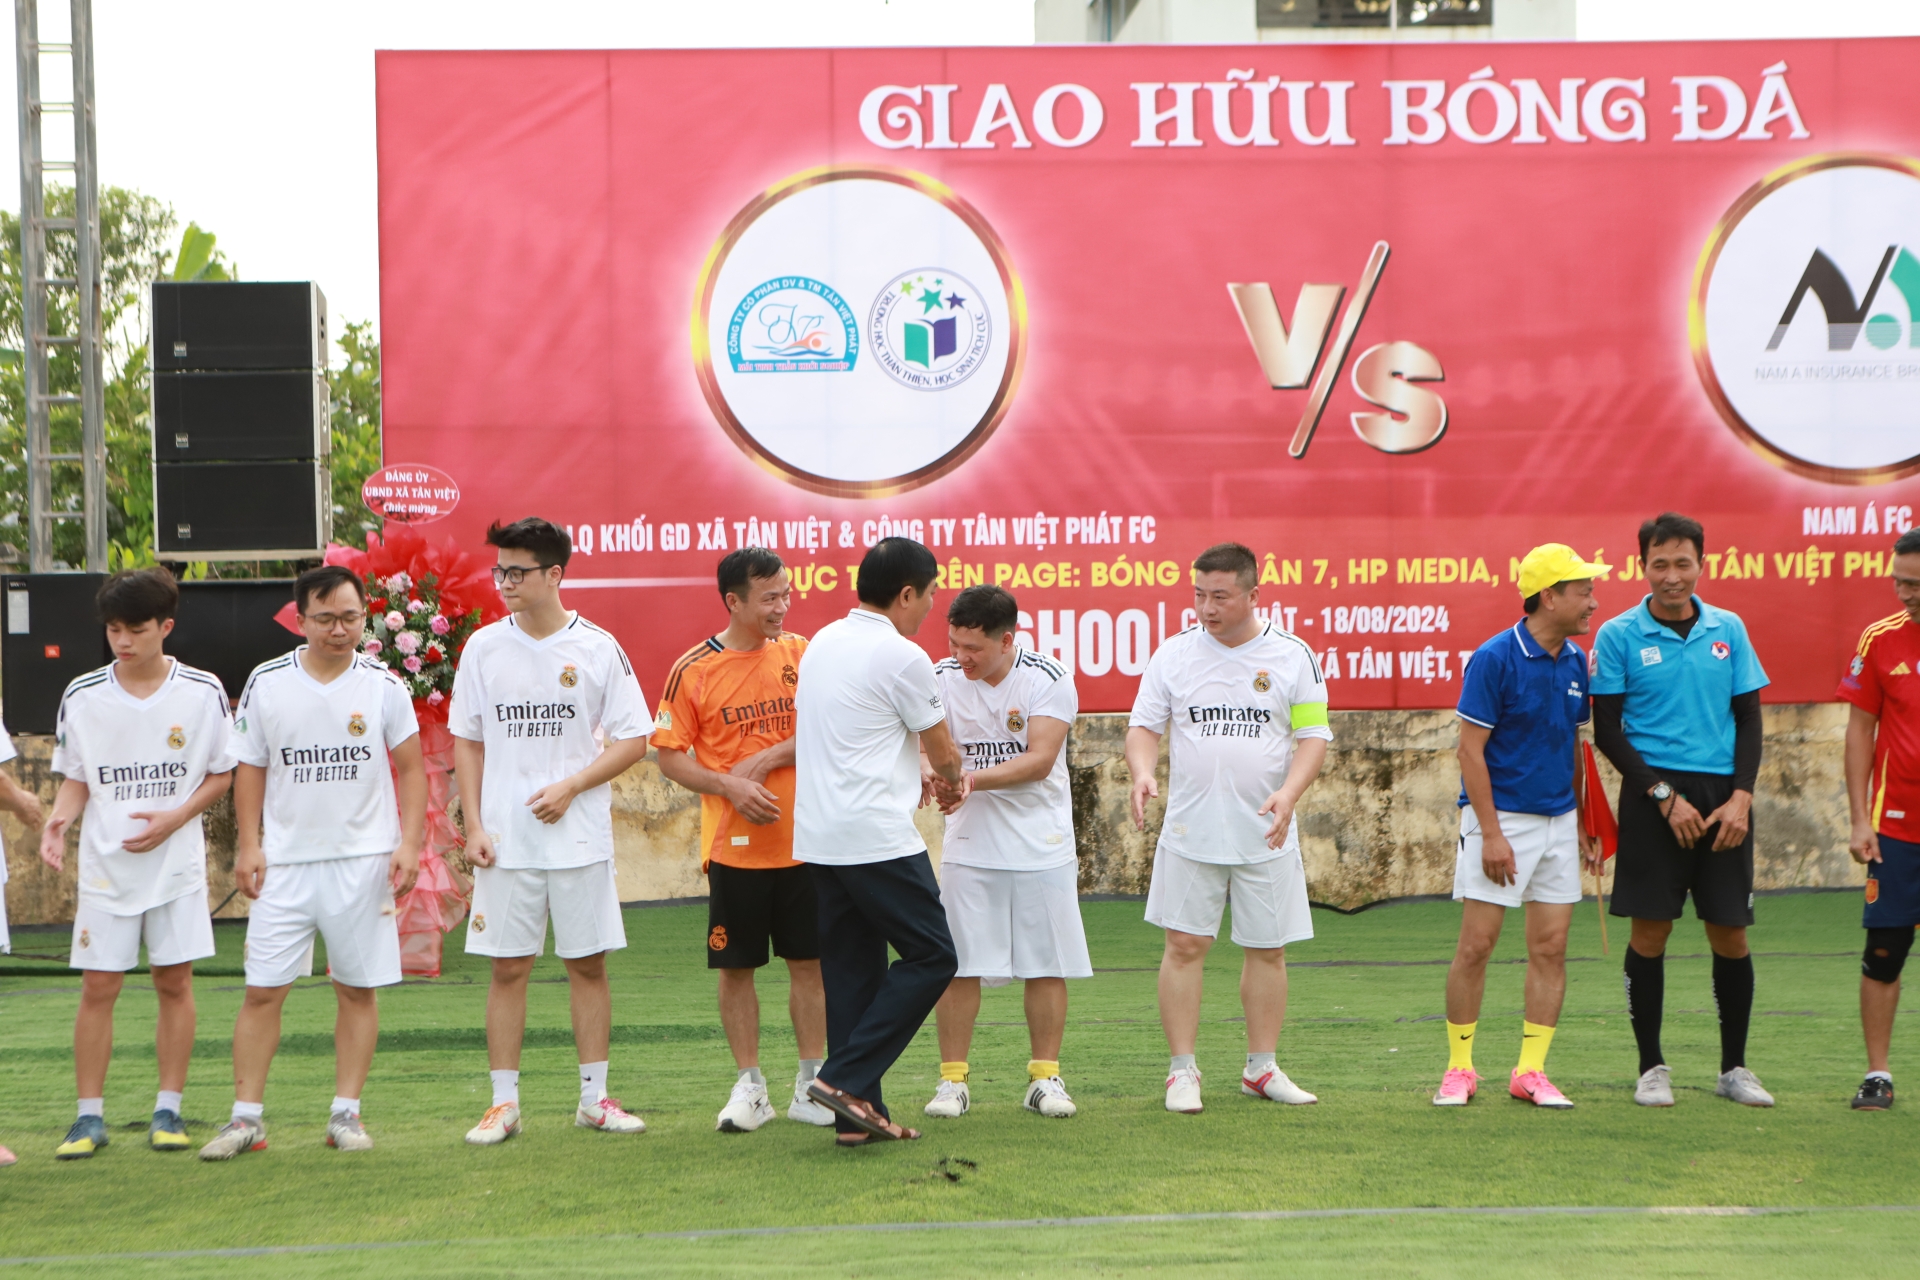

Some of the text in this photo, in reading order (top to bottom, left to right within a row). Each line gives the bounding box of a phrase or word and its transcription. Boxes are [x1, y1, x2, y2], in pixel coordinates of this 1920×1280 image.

[859, 60, 1810, 149] GIAO HỮU BÓNG ĐÁ
[735, 310, 745, 324] TY
[782, 279, 797, 288] DV
[798, 279, 805, 288] &
[808, 280, 822, 293] TM
[956, 356, 976, 376] SINH
[1755, 366, 1788, 379] NAM
[1805, 365, 1893, 379] INSURANCE
[365, 486, 393, 497] UBND
[1803, 501, 1913, 536] NAM Á FC
[601, 514, 653, 552] KHỐI
[660, 523, 690, 551] GD
[697, 517, 728, 550] XÃ
[733, 516, 778, 549] TÂN
[784, 515, 831, 554] VIỆT
[838, 520, 855, 548] &
[862, 514, 924, 548] CÔNG
[930, 518, 956, 546] TY
[962, 512, 1006, 546] TÂN
[1012, 511, 1059, 551] VIỆT
[1065, 511, 1123, 544] PHÁT
[1129, 515, 1156, 543] FC
[935, 556, 984, 589] RÊN
[994, 562, 1080, 588] PAGE:
[1091, 554, 1180, 587] BÓNG
[1257, 552, 1302, 585] ÂN
[1313, 559, 1338, 589] 7,
[1348, 558, 1388, 584] HP
[1397, 557, 1499, 587] MEDIA,
[1706, 546, 1764, 580] TÂN
[1774, 545, 1835, 586] VIỆT
[1321, 604, 1450, 634] 18/08/2024
[1346, 646, 1393, 679] TÂN
[1399, 645, 1452, 684] VIỆT,
[495, 701, 576, 722] Emirates
[721, 696, 796, 725] Emirate
[1189, 704, 1271, 724] Emirates
[508, 721, 563, 738] FLY BETTER
[740, 716, 791, 738] FLY BETTER
[1201, 723, 1261, 738] FLY BETTER
[281, 744, 372, 766] Emirates
[98, 761, 187, 785] Emirates
[294, 764, 358, 783] FLY BETTER
[115, 781, 176, 801] FLY BETTER
